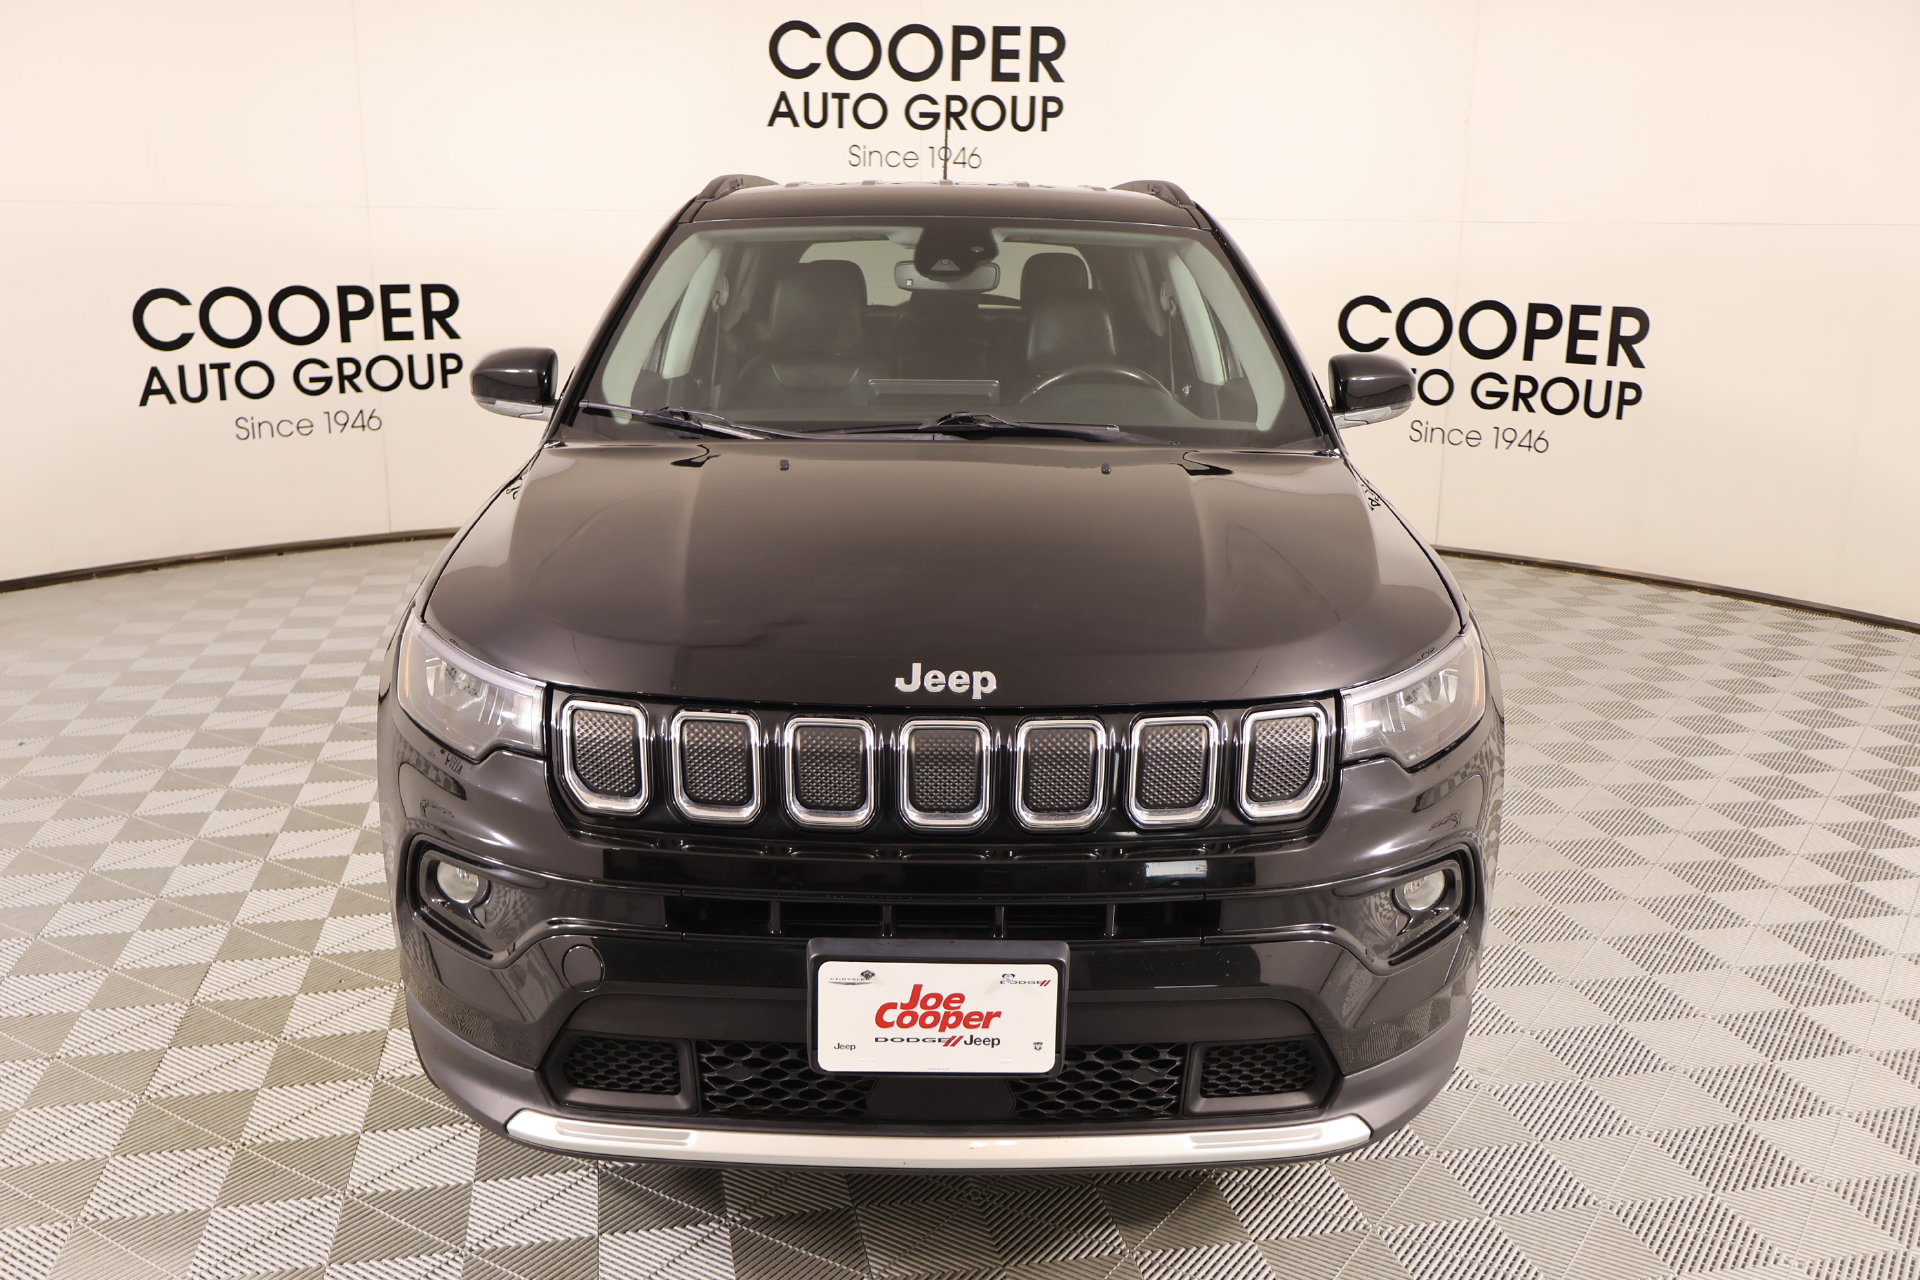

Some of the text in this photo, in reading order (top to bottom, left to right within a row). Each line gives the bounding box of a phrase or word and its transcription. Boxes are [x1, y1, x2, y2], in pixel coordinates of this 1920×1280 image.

[769, 20, 1066, 83] COOPER
[767, 91, 1064, 132] AUTO GROUP
[848, 144, 982, 169] Since 1946
[132, 283, 462, 351] COOPER
[1338, 295, 1650, 369] COOPER
[139, 353, 463, 407] AUTO GROUP
[1471, 371, 1643, 420] GROUP
[235, 408, 382, 441] Since 1946
[1409, 420, 1549, 454] Since 1946
[895, 662, 997, 700] Jeep
[900, 984, 965, 1010] Joe
[875, 1003, 1001, 1032] Cooper
[834, 1042, 856, 1051] Jeep
[964, 1034, 1000, 1048] Jeep
